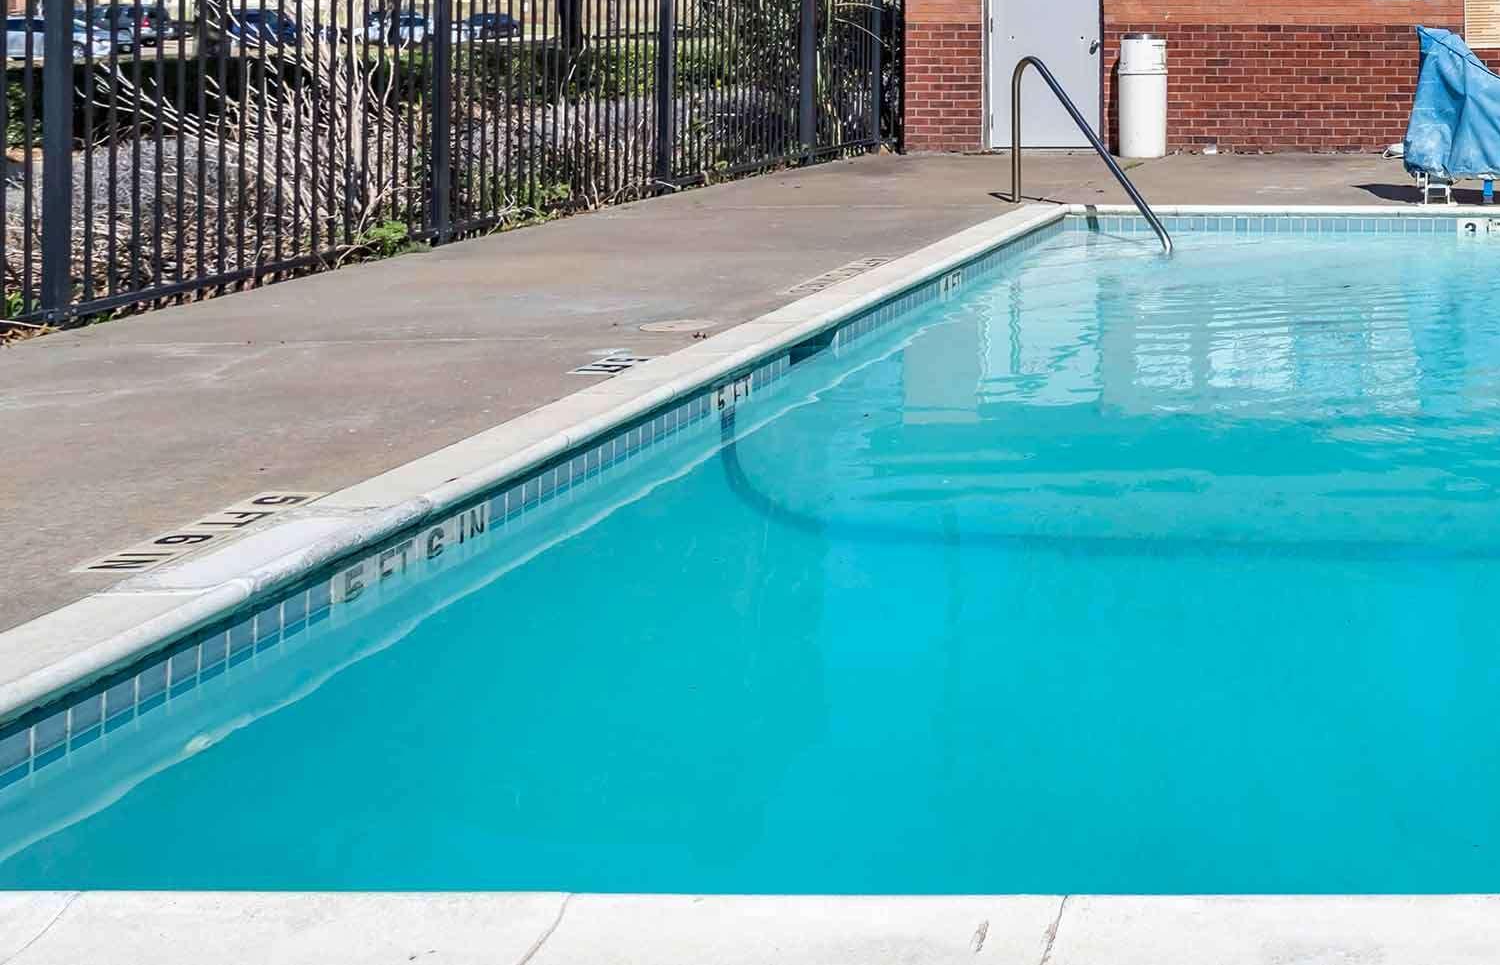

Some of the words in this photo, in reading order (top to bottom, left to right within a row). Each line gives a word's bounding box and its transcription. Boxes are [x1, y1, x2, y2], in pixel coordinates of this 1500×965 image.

[734, 378, 750, 403] FT
[199, 512, 276, 528] FT
[460, 505, 485, 544] IN
[88, 552, 176, 570] IN
